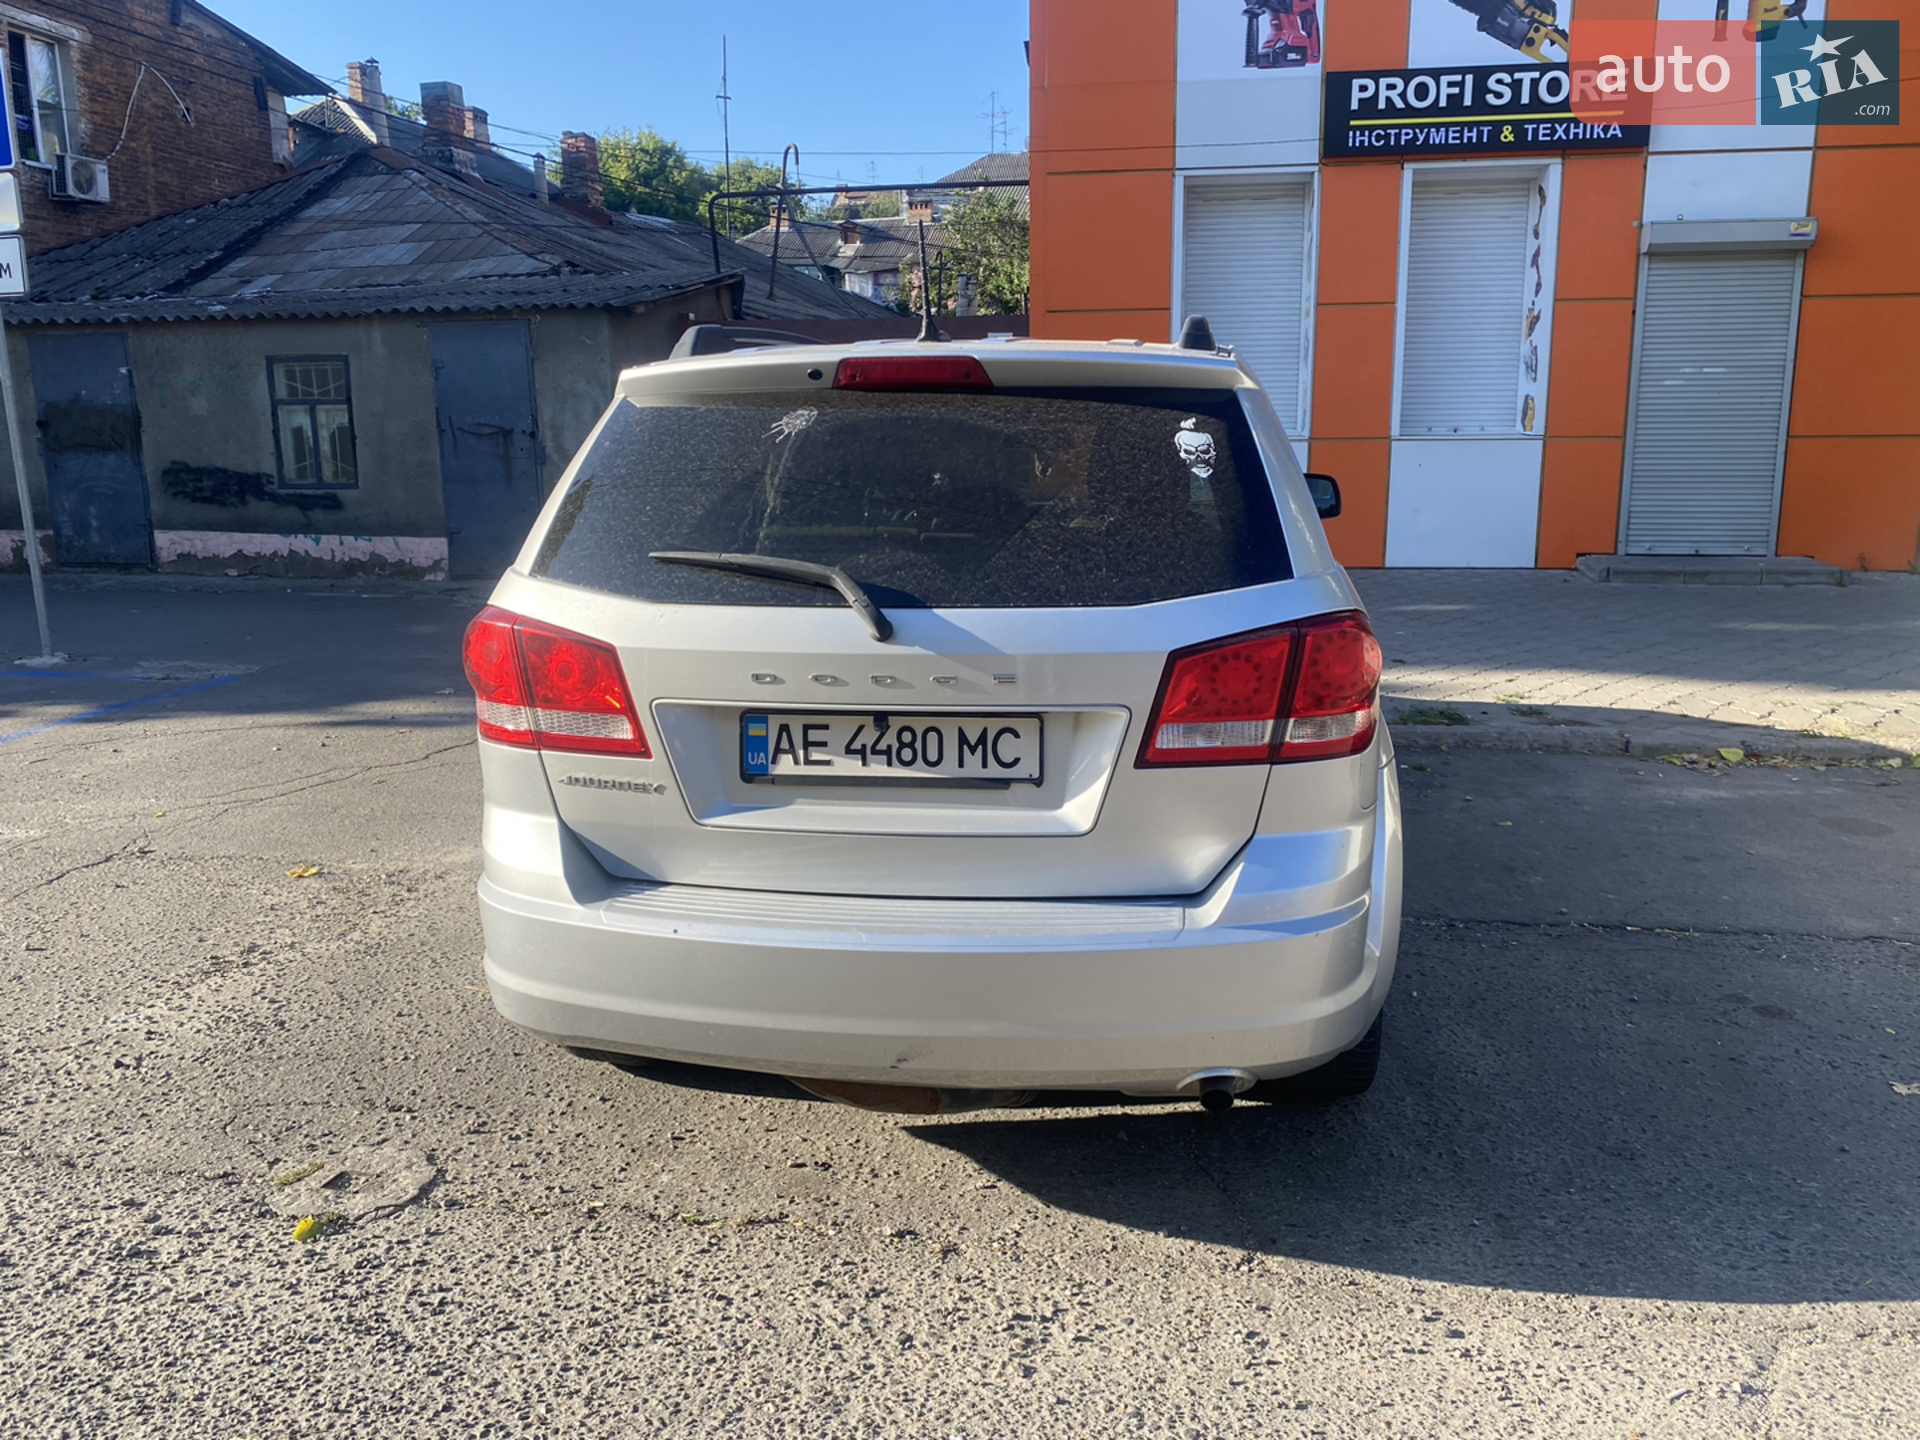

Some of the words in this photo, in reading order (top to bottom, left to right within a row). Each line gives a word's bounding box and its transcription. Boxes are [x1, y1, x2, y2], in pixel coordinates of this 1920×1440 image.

[1350, 73, 1474, 111] PROFI
[1485, 67, 1630, 107] STORE
[1348, 126, 1493, 147] ІНСТРУМЕНТ
[1500, 125, 1515, 142] &
[1523, 120, 1624, 141] ТЕХНІКА
[751, 672, 1017, 685] DODGE
[770, 723, 832, 766] AE
[844, 724, 944, 768] 4480
[957, 726, 1022, 769] MC
[748, 752, 767, 765] UA
[557, 775, 668, 796] JOURNEY
